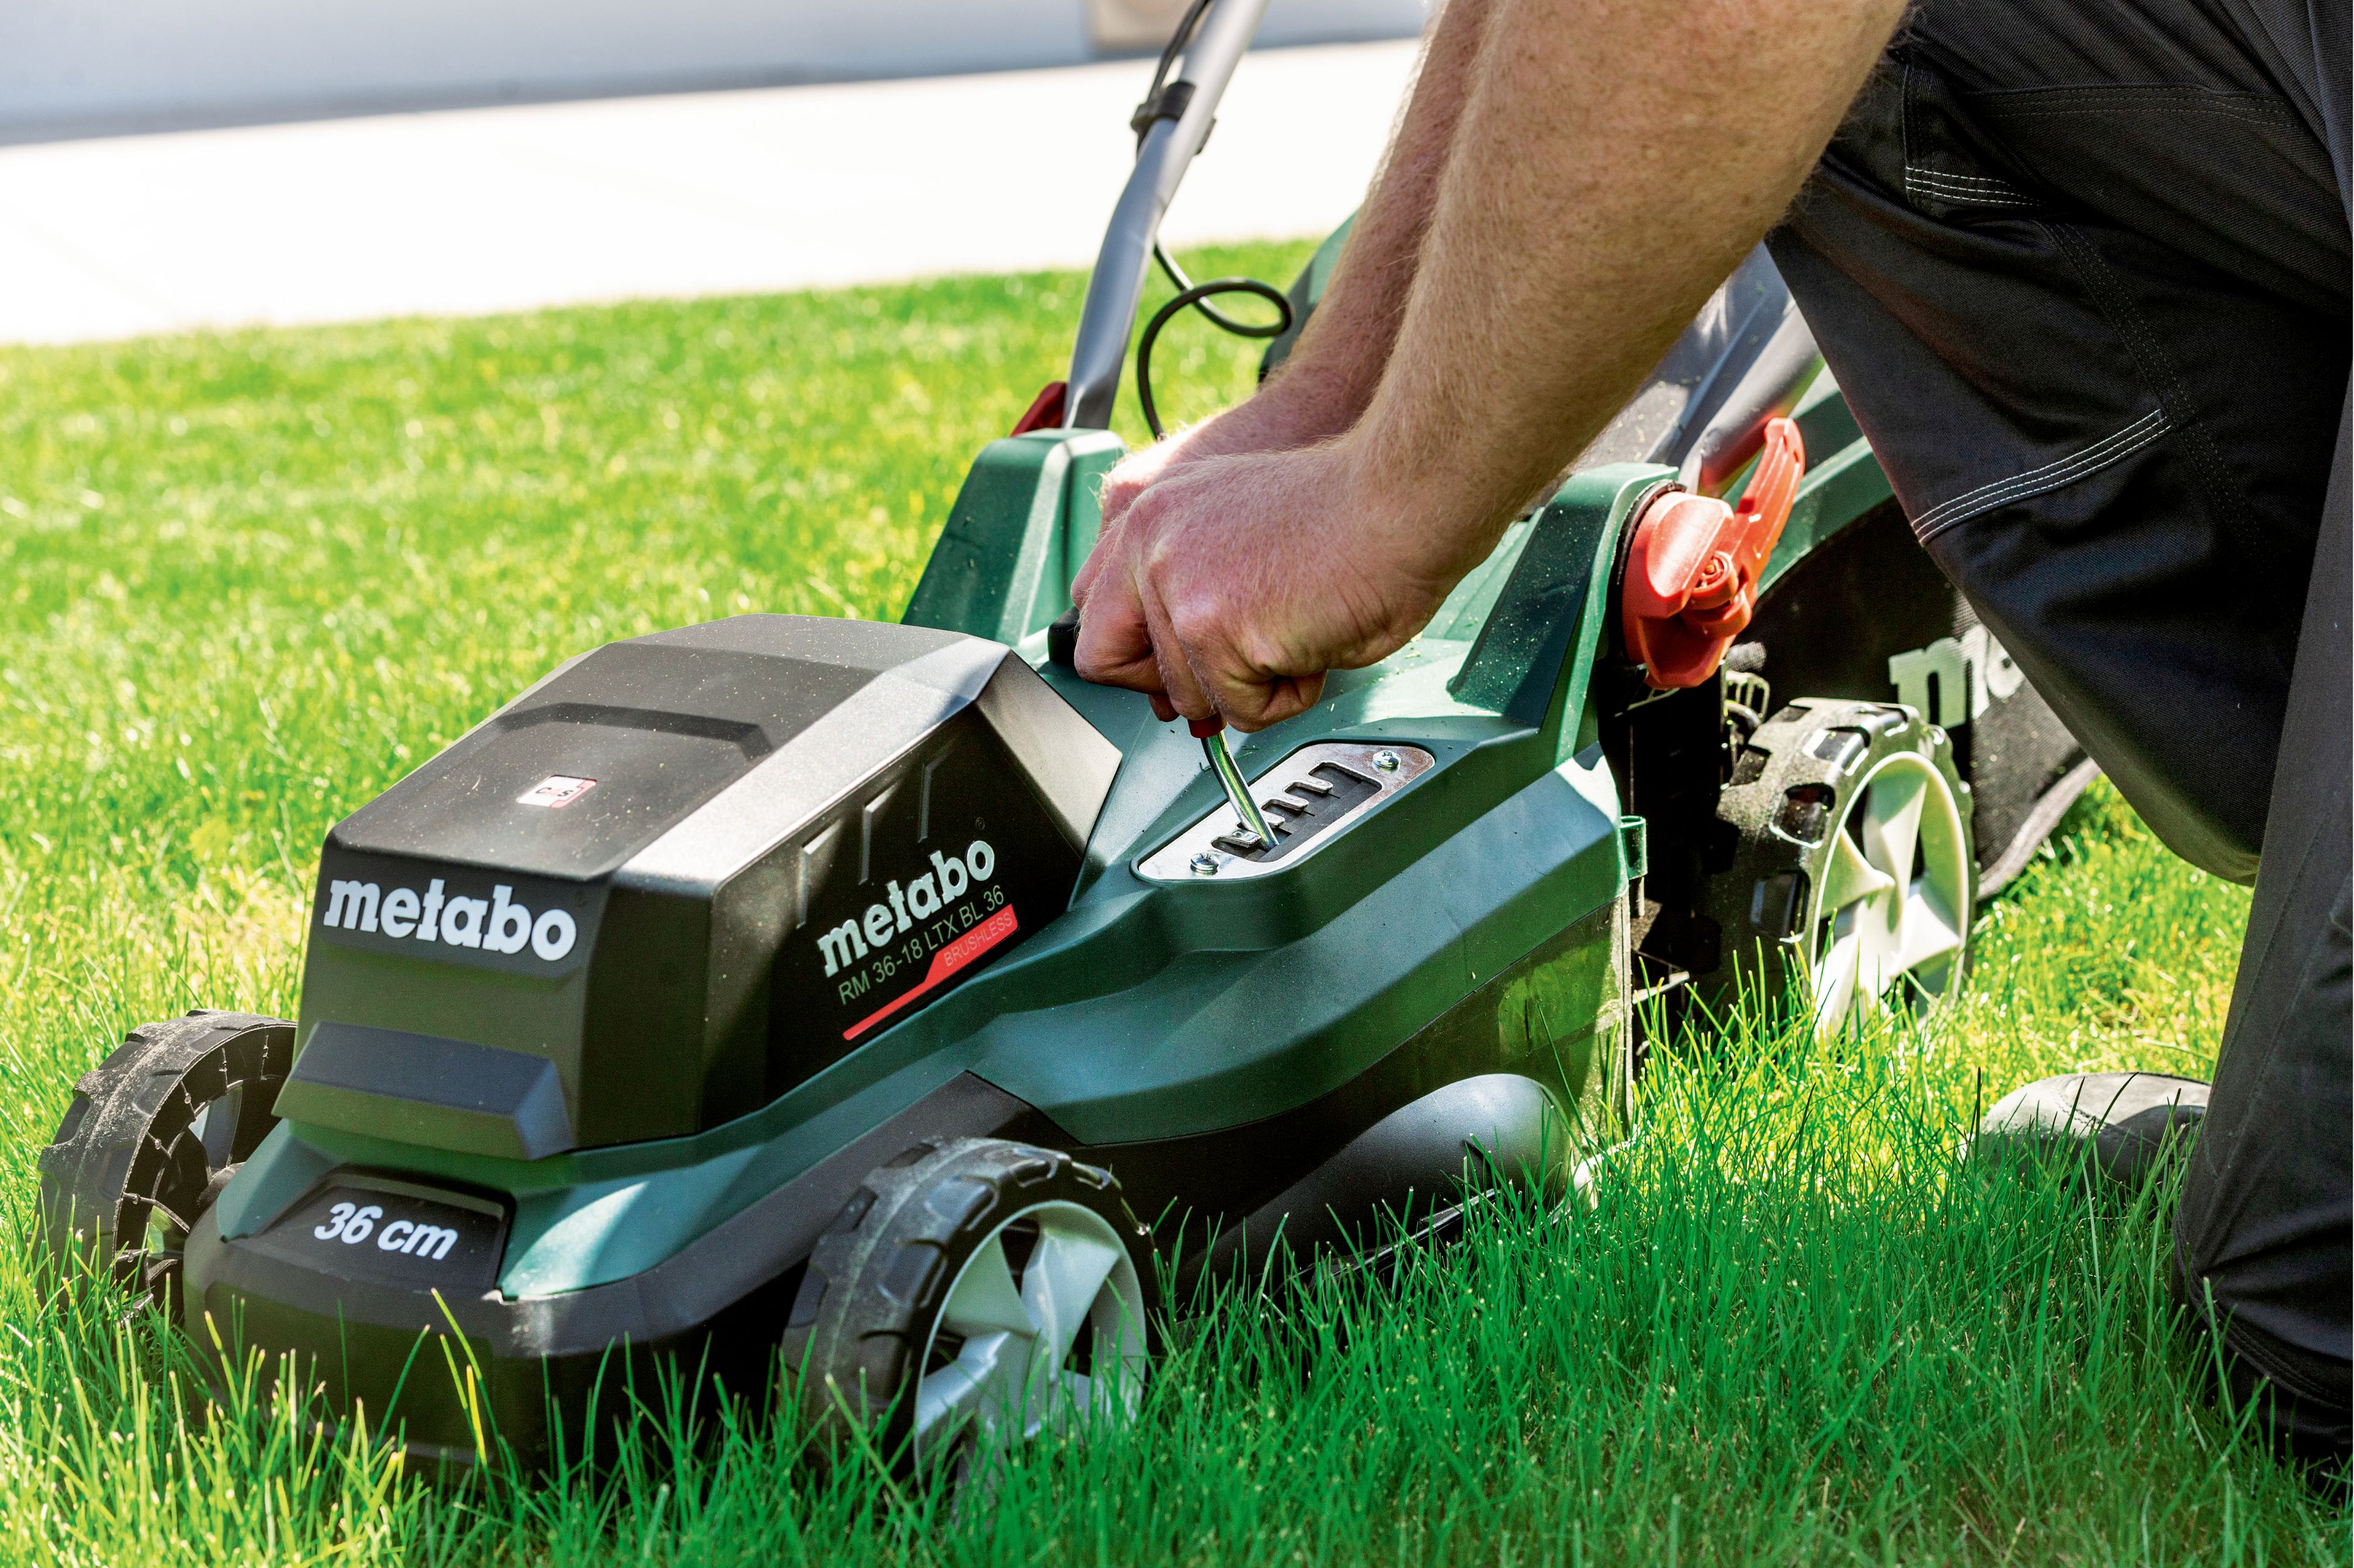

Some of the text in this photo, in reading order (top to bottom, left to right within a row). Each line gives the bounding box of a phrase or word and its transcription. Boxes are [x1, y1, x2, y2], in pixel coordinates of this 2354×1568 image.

[535, 787, 574, 797] CS
[324, 878, 576, 961] metabo
[817, 840, 995, 978] metabo
[943, 912, 1013, 967] BRUSHLESS
[838, 885, 1004, 1005] RM 36-18 LTX BL 36
[314, 1202, 458, 1260] 36 cm
